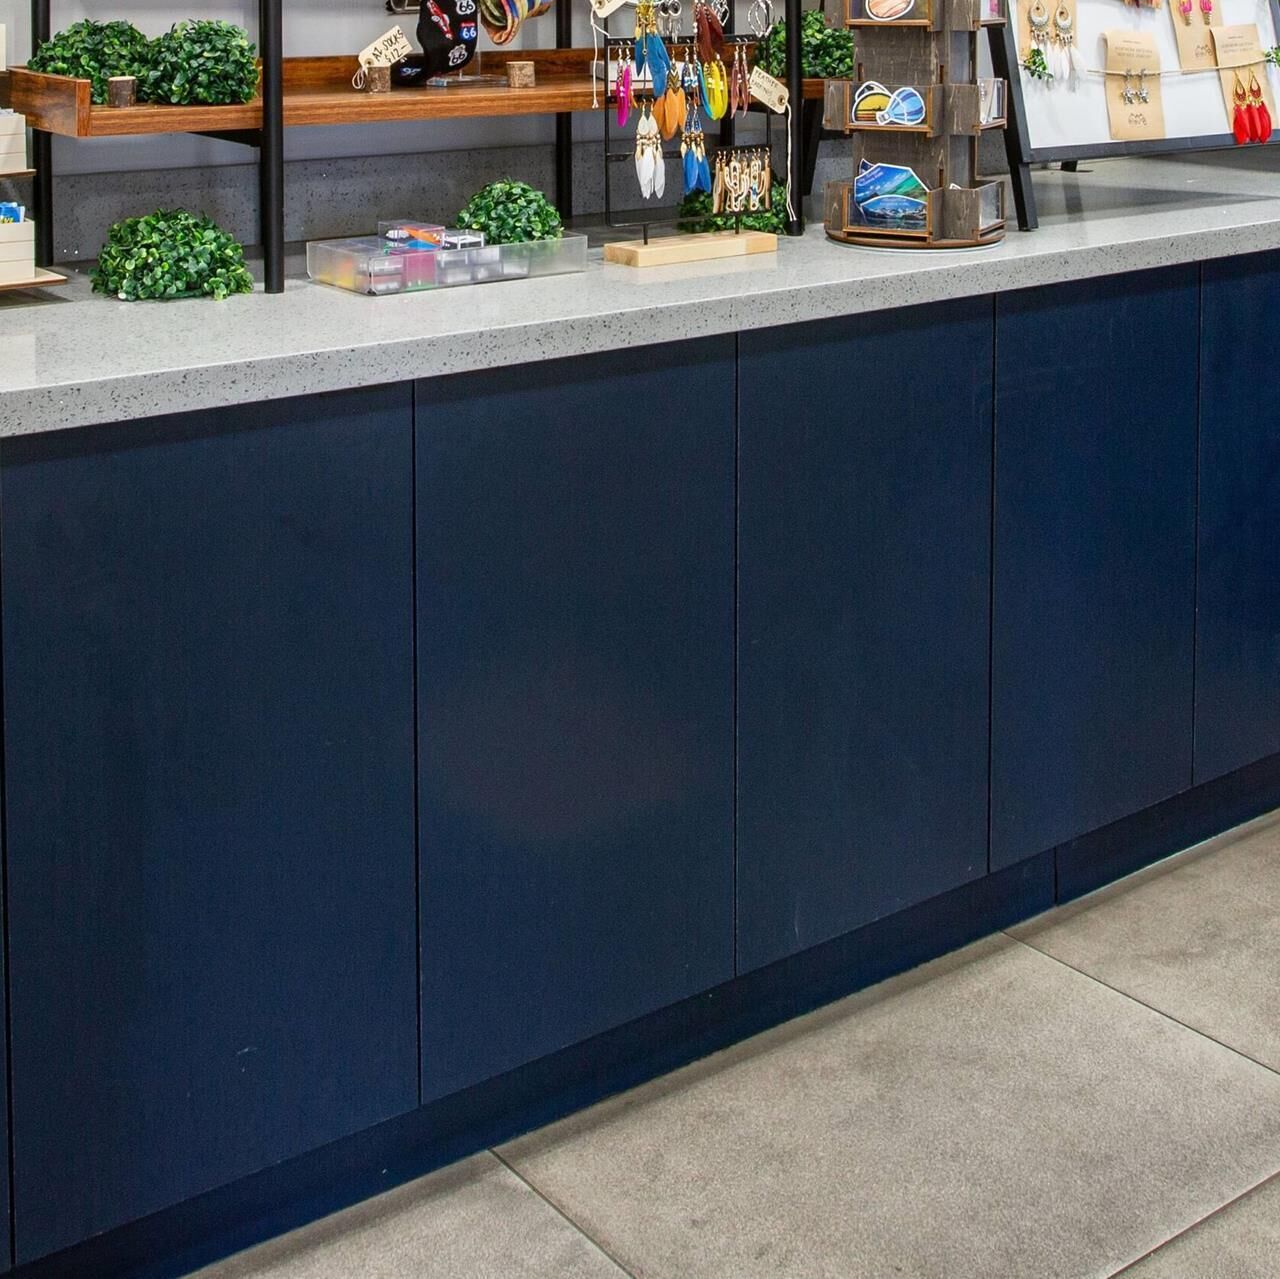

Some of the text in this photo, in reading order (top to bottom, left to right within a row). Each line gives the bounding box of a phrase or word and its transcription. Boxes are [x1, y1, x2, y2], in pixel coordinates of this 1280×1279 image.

[458, 0, 475, 12] 66
[462, 27, 477, 38] 66
[450, 52, 466, 63] 66
